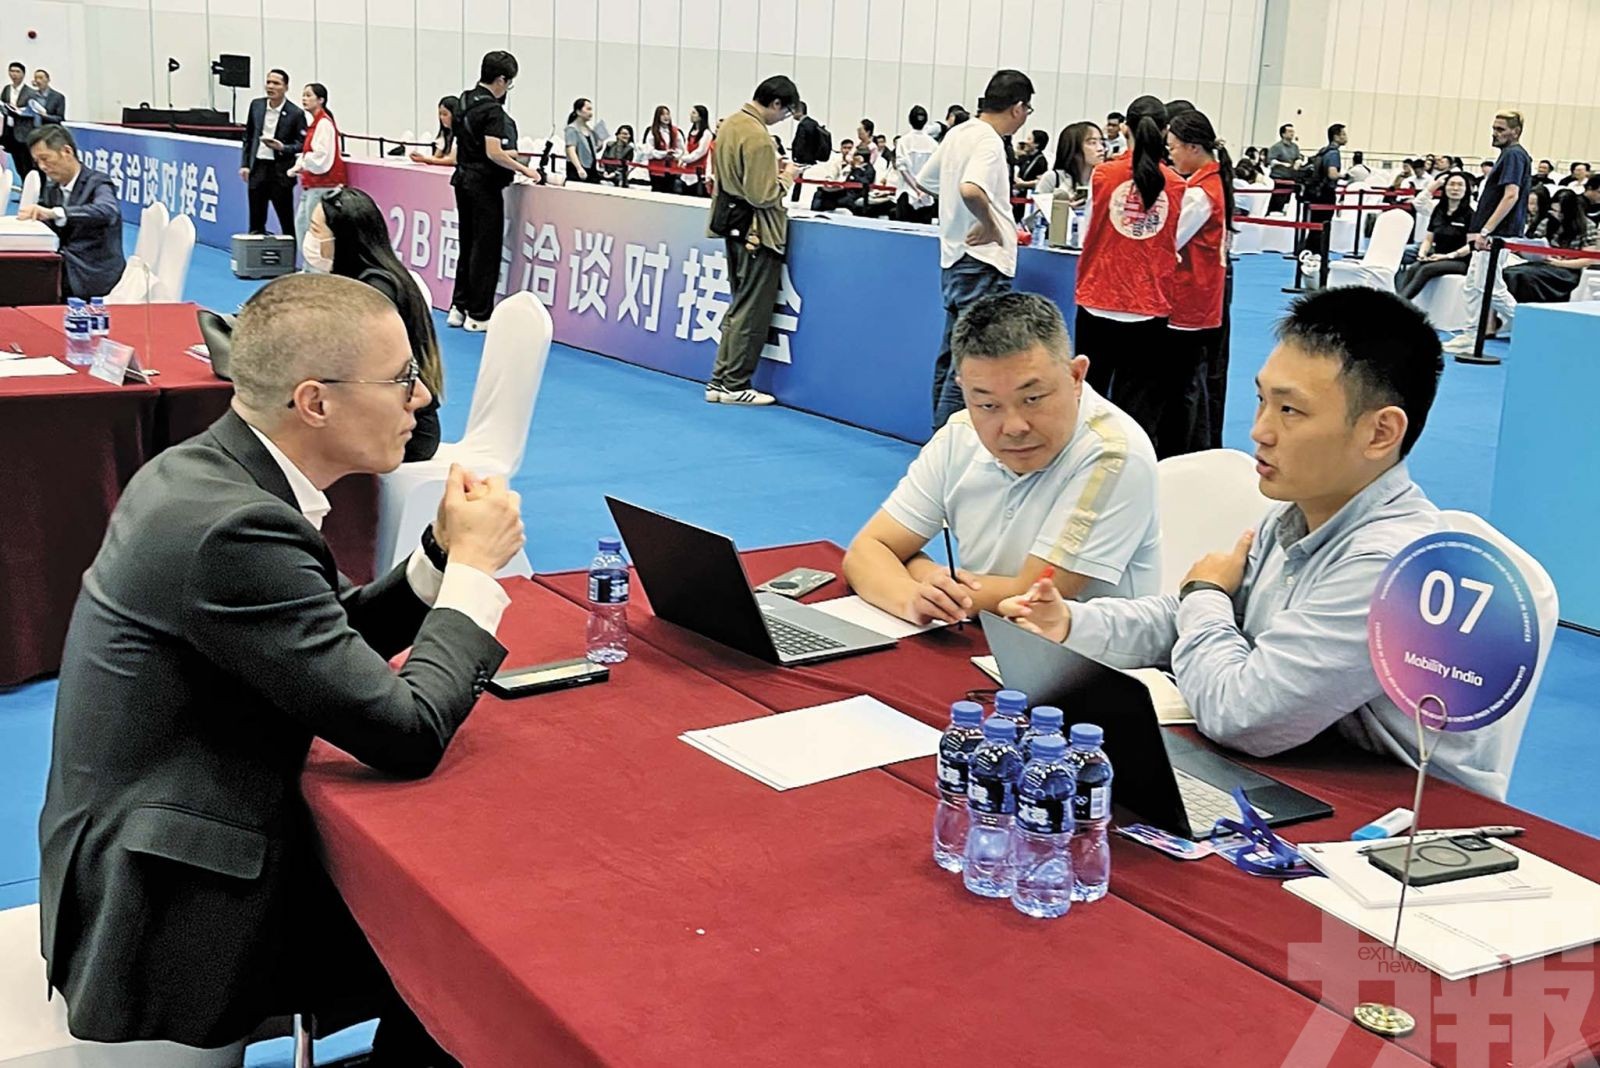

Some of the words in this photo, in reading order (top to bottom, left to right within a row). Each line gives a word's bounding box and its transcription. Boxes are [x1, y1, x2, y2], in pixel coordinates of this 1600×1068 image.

[1419, 570, 1494, 634] 07
[1404, 651, 1450, 679] Mobility
[1451, 666, 1484, 687] India
